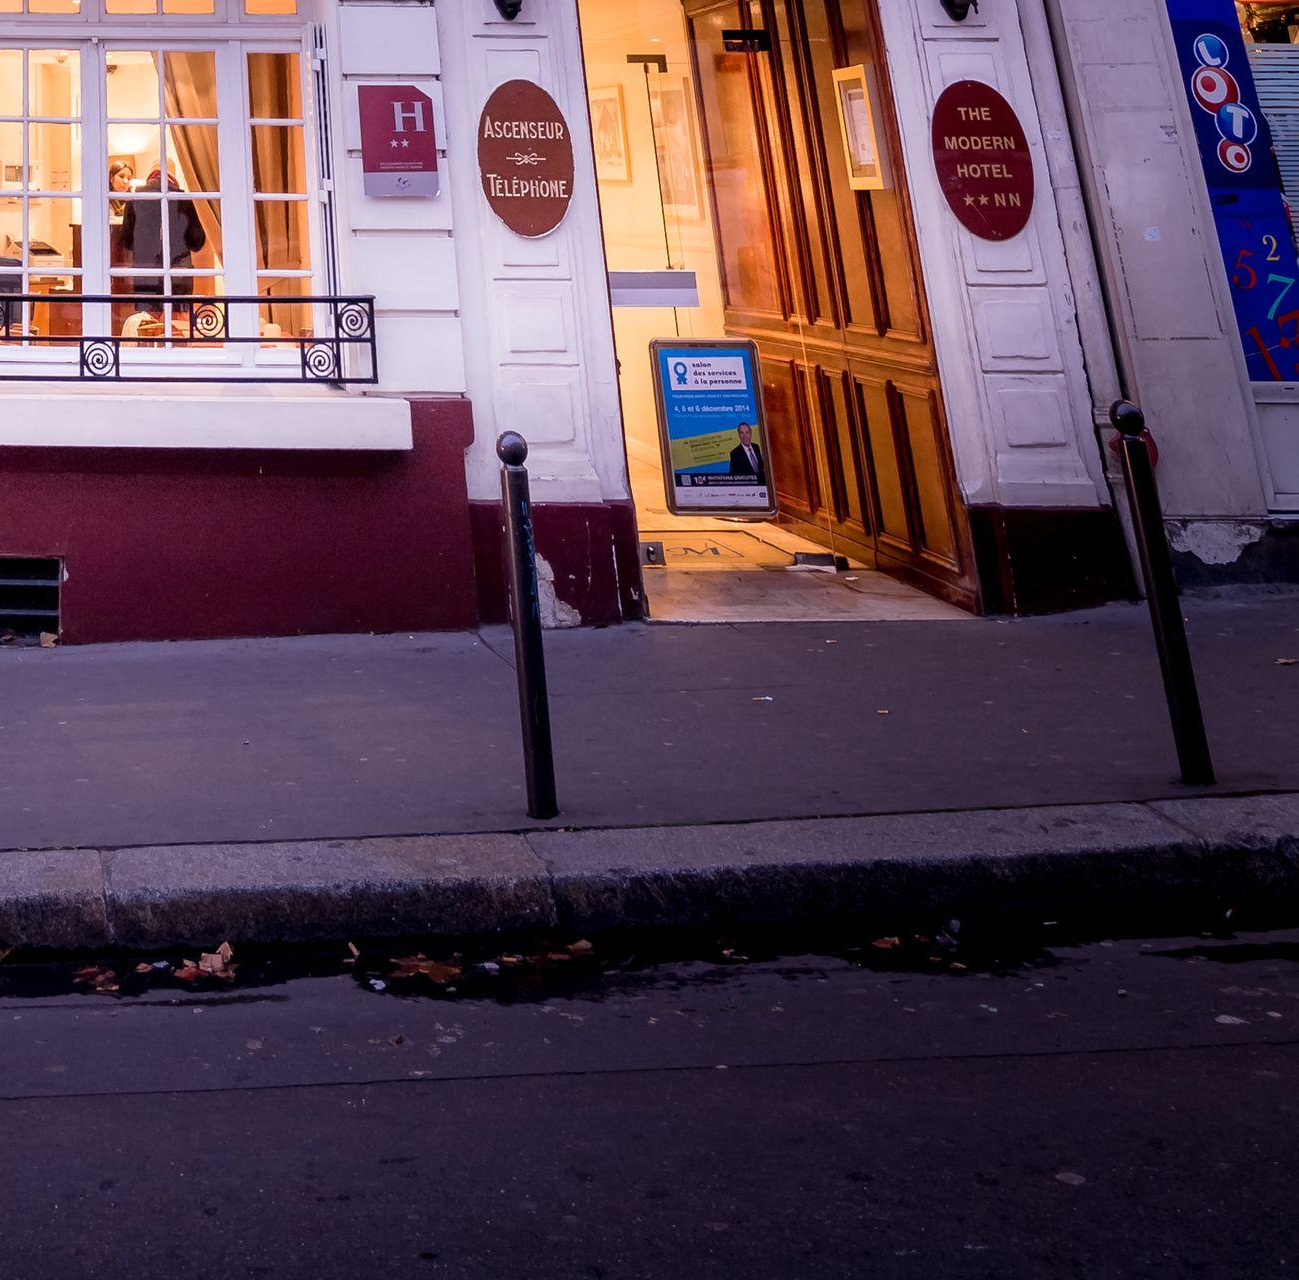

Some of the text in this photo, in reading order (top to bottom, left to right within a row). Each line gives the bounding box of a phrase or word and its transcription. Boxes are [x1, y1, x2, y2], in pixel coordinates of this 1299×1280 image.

[390, 101, 428, 132] H
[957, 107, 992, 121] THE
[483, 115, 564, 140] ASCENSEUR
[944, 136, 1016, 150] MODERN
[957, 164, 1013, 178] HOTEL
[1262, 234, 1280, 261] 2
[1233, 249, 1257, 289] 5
[1267, 274, 1295, 320] 7
[709, 378, 742, 387] personne
